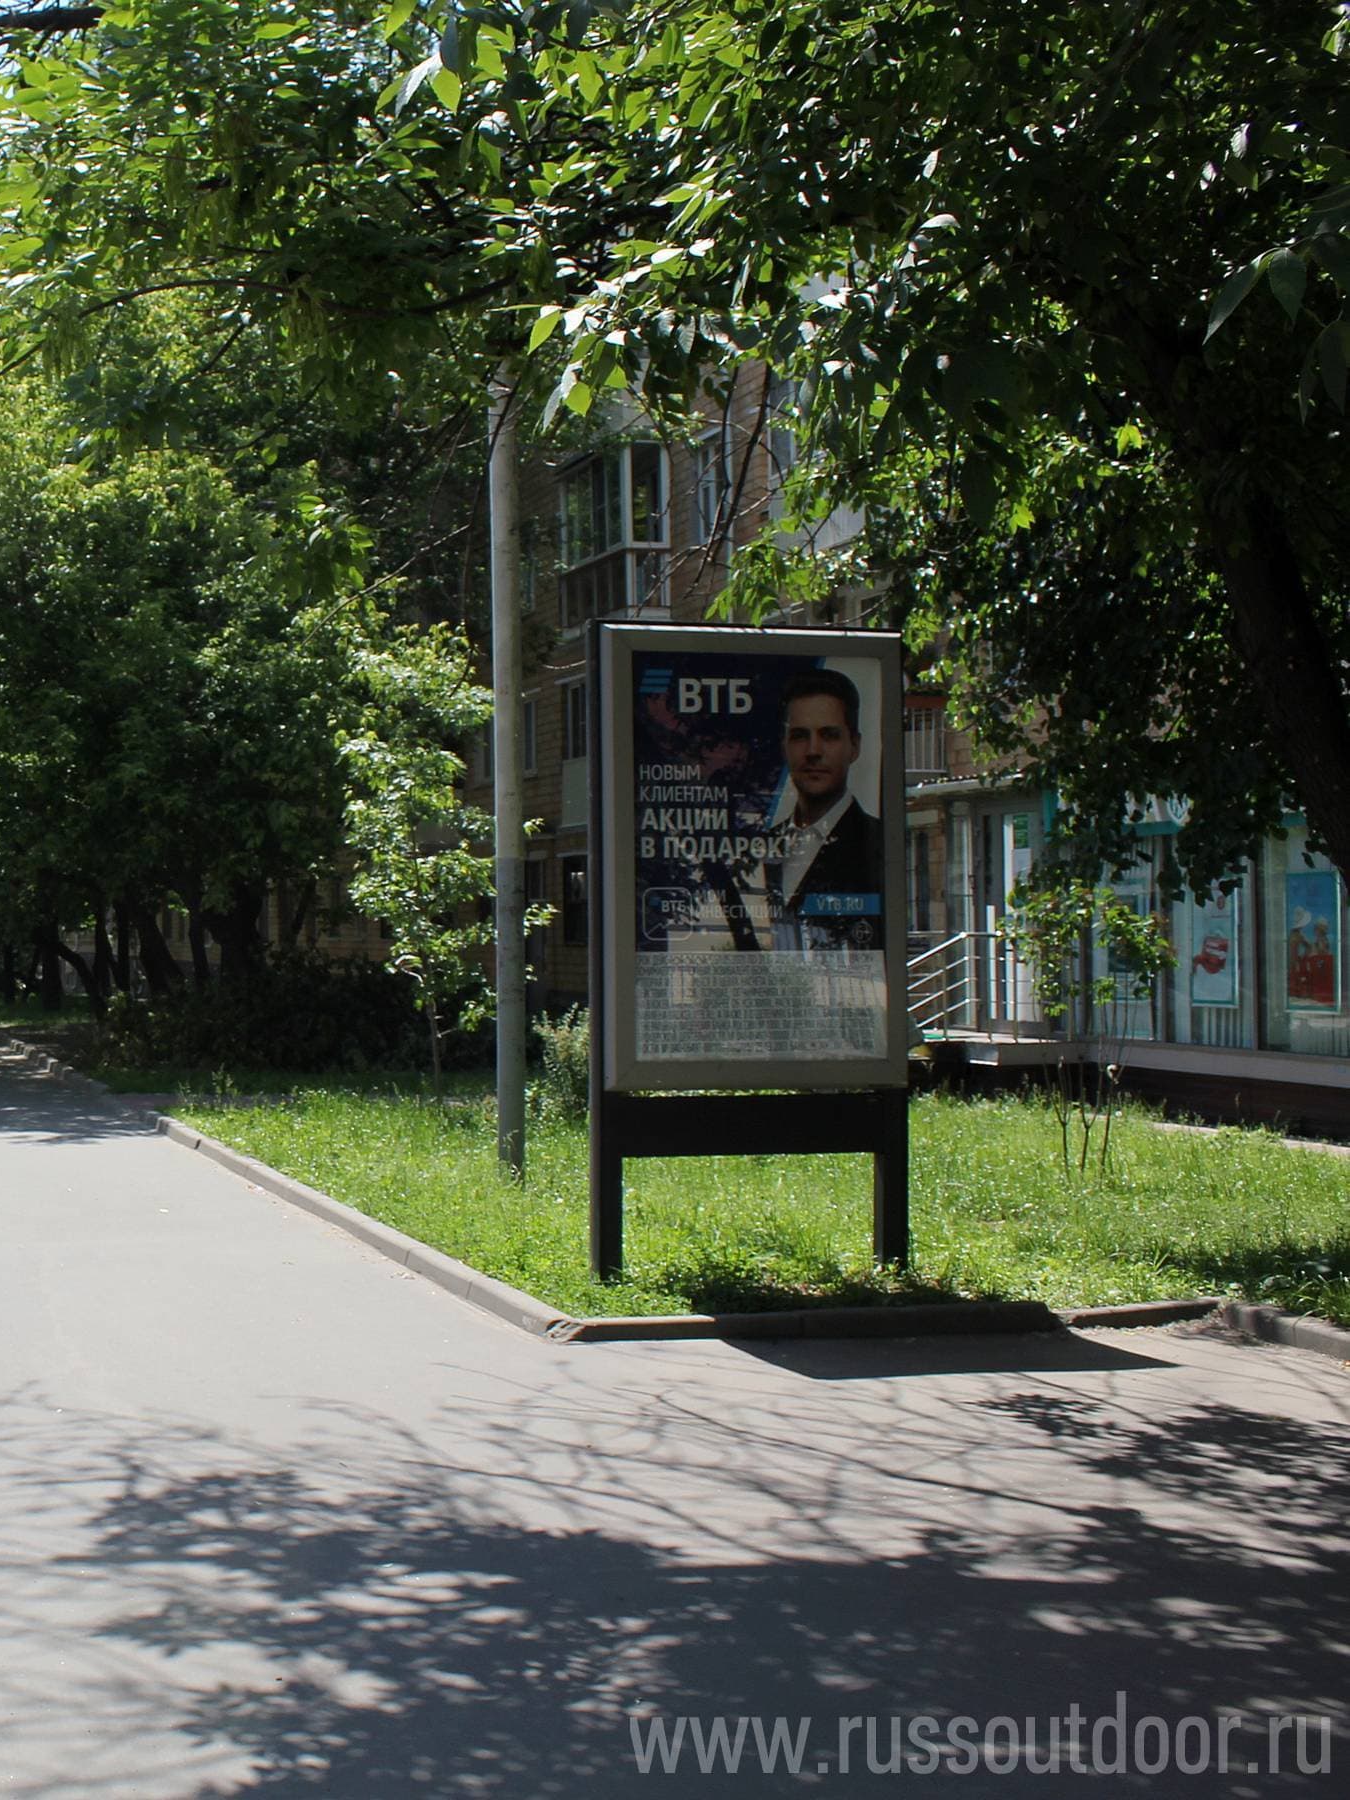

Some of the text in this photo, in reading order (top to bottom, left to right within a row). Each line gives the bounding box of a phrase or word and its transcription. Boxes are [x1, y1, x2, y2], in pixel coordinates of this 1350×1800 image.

[677, 677, 754, 714] ВТБ
[638, 763, 701, 781] НОВЫМ
[638, 786, 729, 802] КЛИЕНТАМ
[640, 807, 729, 833] АКЦИИ
[640, 836, 791, 863] В ПОДАРОК!
[661, 900, 686, 913] ВТБ
[816, 898, 864, 911] VTB.RU
